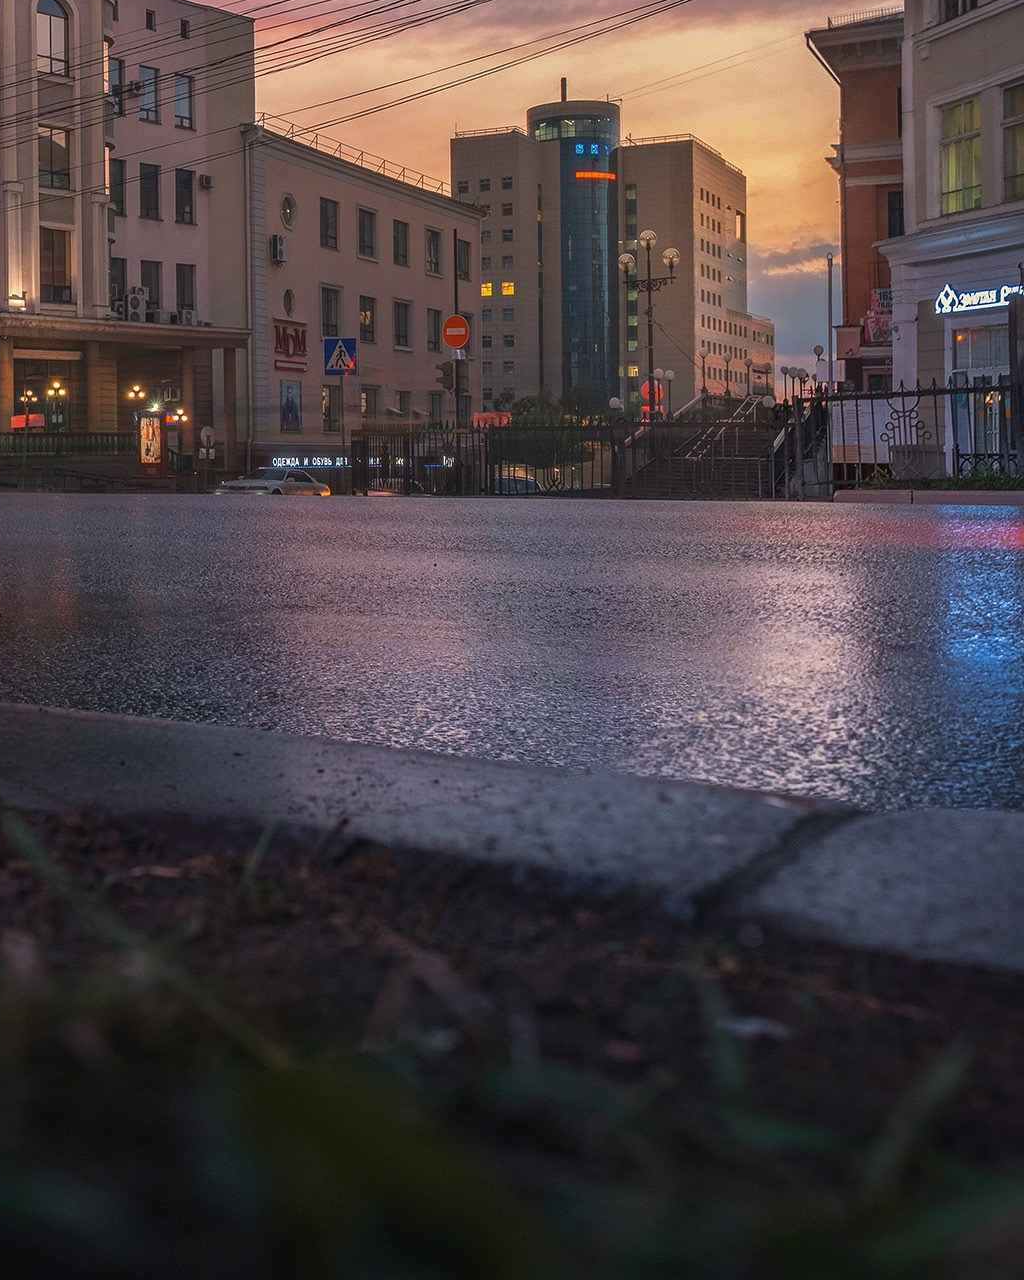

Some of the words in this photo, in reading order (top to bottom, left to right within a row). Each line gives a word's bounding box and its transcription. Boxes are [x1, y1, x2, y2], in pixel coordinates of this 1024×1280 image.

[272, 457, 300, 467] ОДЕЖДА
[303, 457, 309, 466] И
[312, 457, 333, 466] ОБУВЬ
